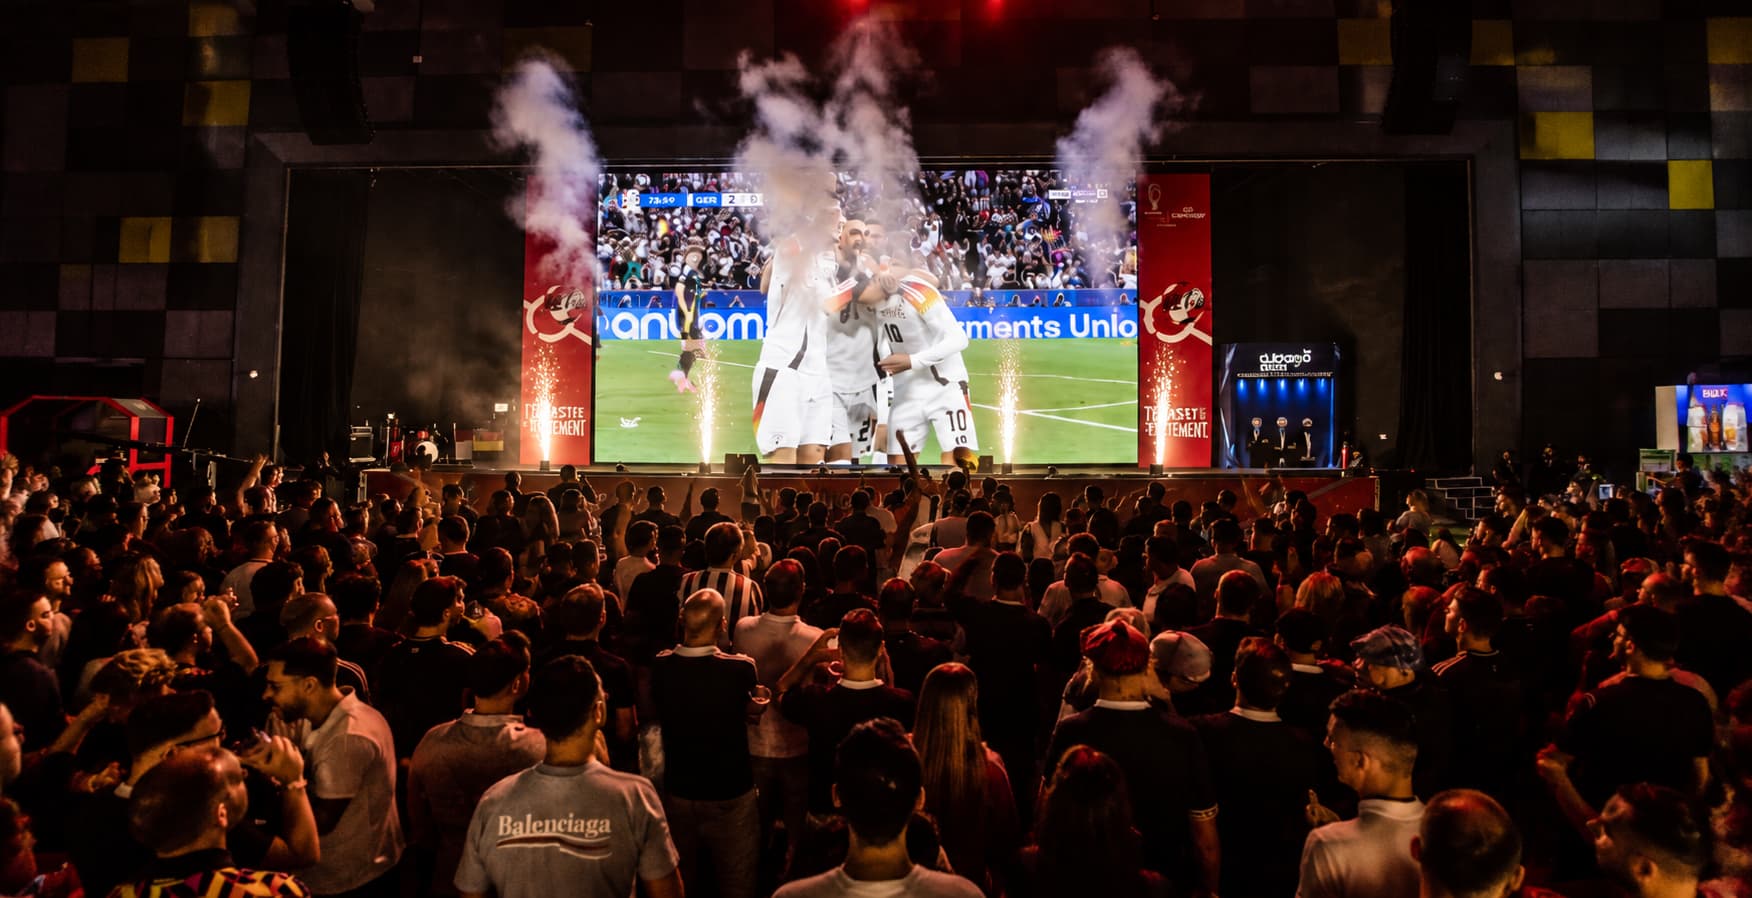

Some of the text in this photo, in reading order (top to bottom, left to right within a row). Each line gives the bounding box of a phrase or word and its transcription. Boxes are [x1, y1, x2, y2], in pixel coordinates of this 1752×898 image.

[695, 196, 718, 204] GER
[728, 195, 735, 204] 2
[957, 315, 1060, 339] ments
[946, 409, 967, 432] 10
[498, 812, 612, 838] Balenciaga
